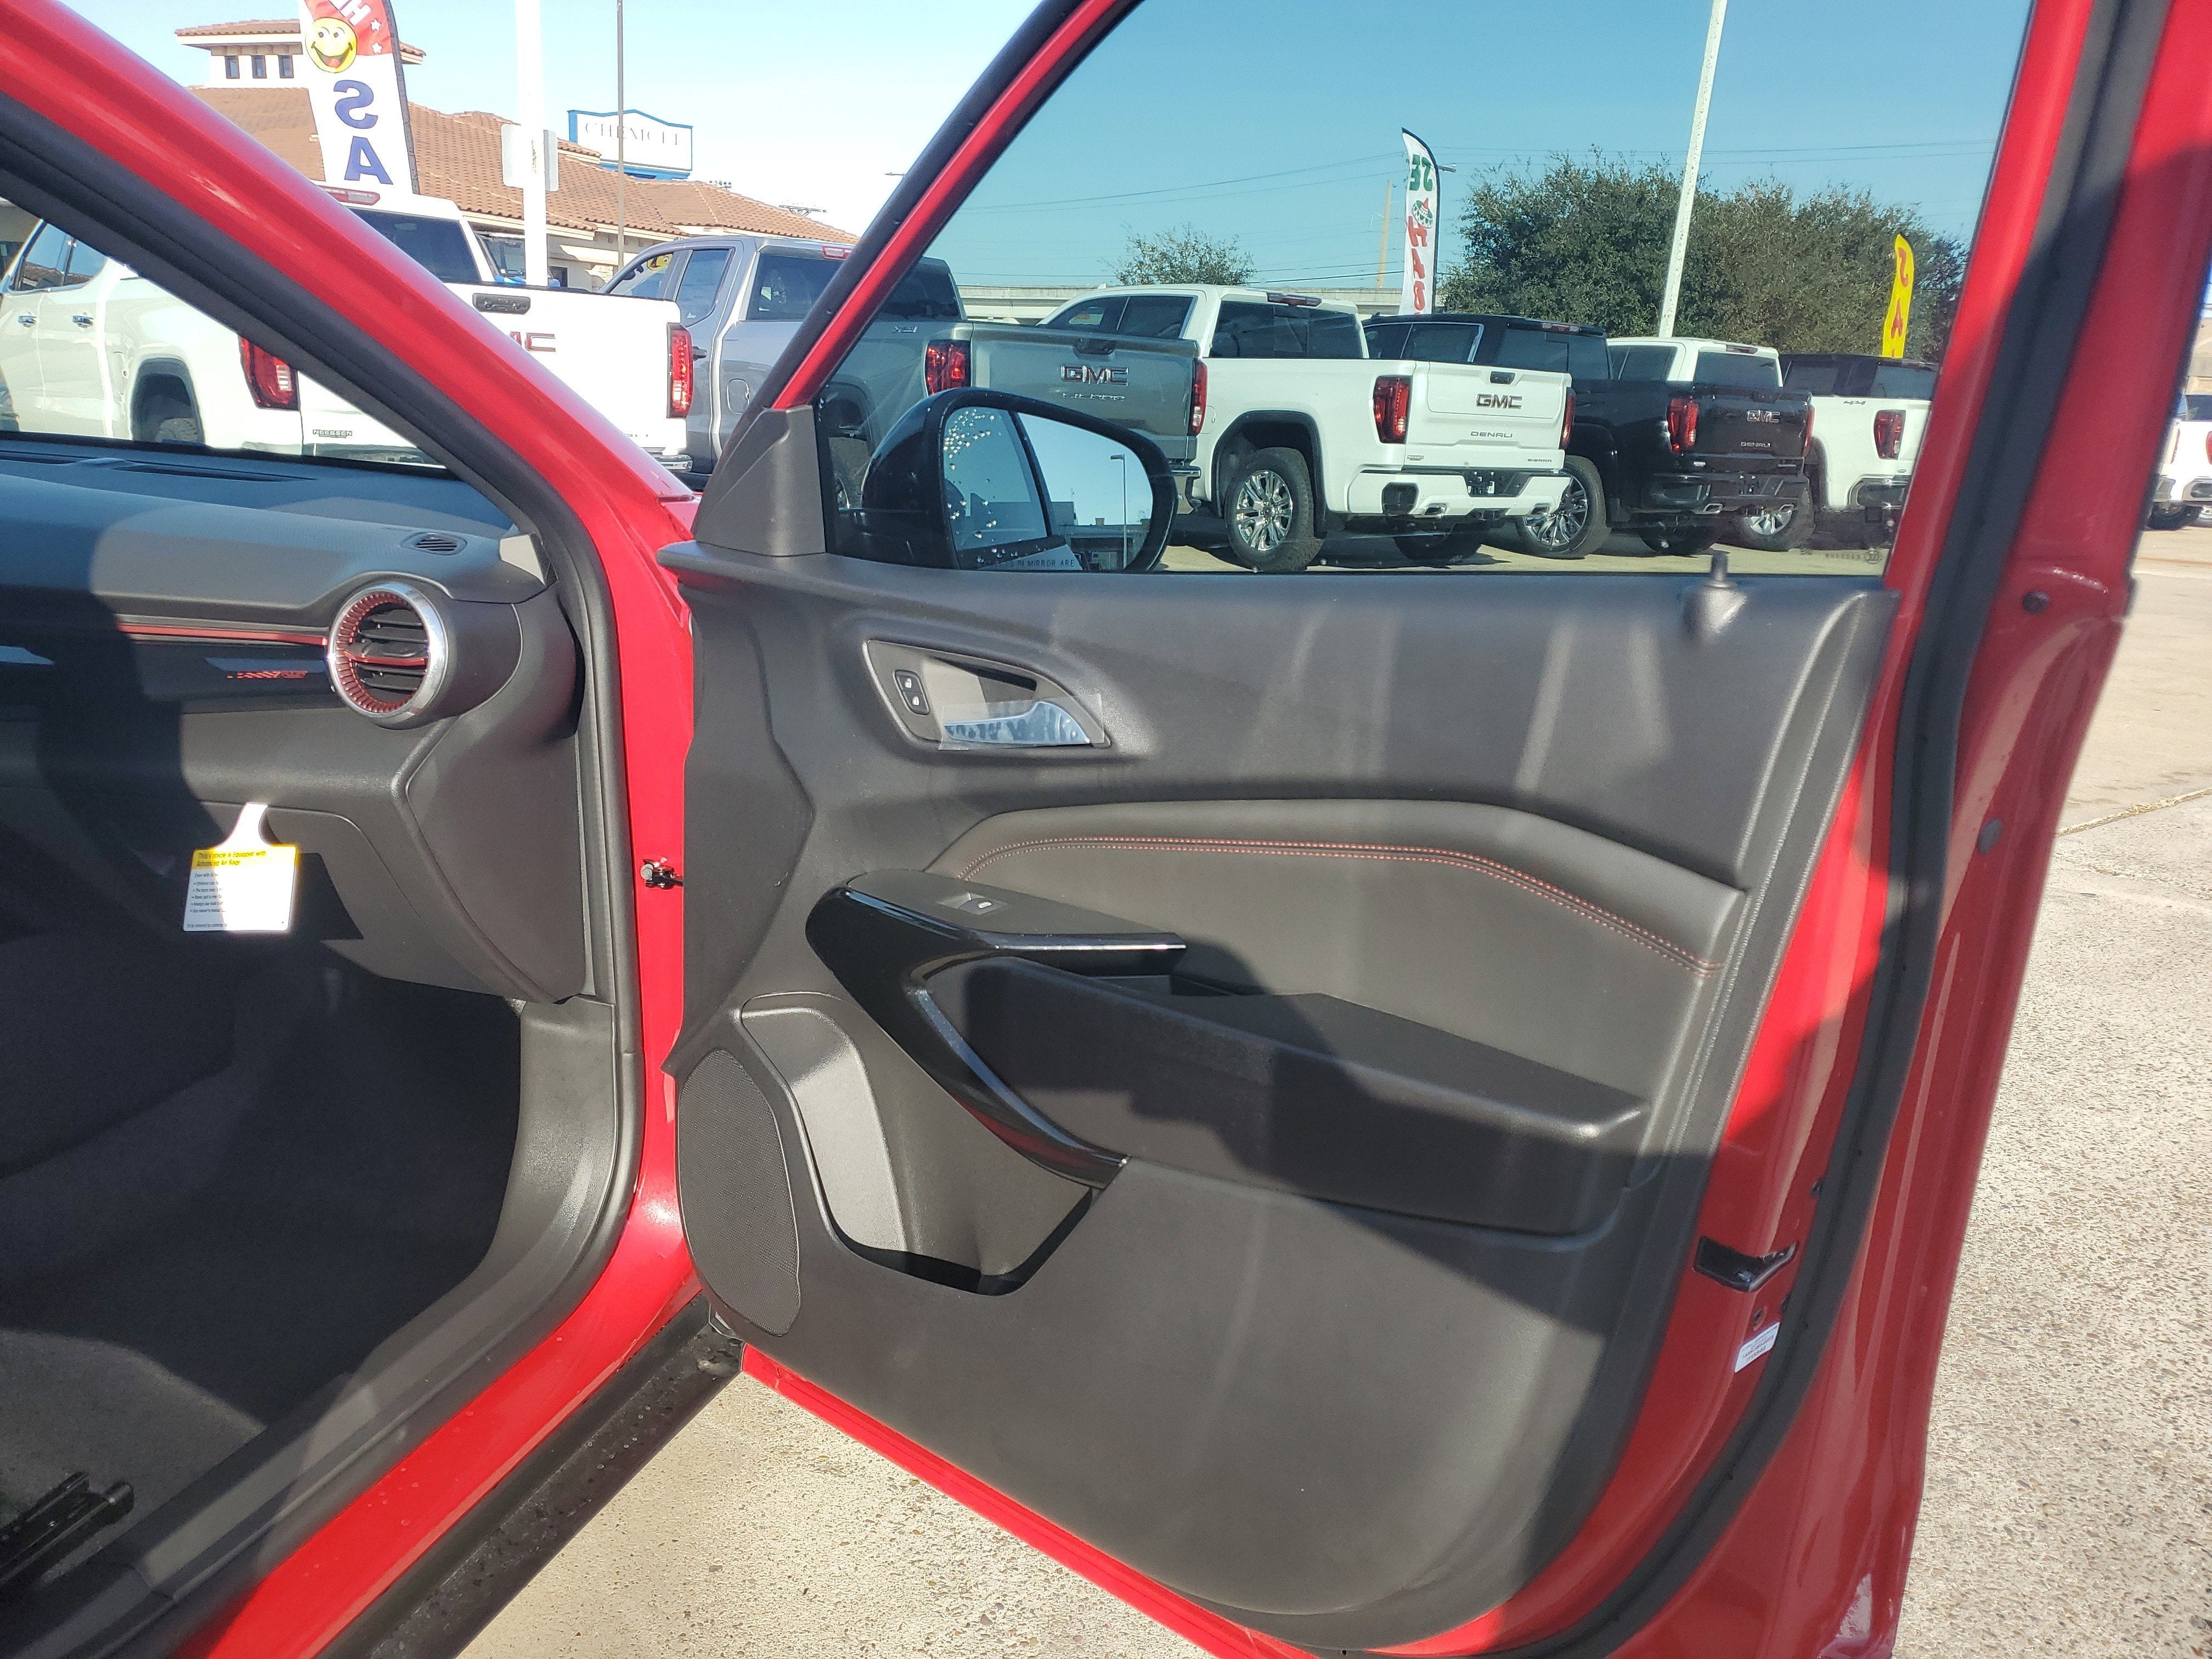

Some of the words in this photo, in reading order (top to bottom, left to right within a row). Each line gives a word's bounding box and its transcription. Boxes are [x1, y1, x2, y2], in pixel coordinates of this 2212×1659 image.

[1060, 364, 1129, 387] GMC
[1476, 393, 1522, 409] GMC
[1746, 409, 1780, 424] GMC
[1028, 559, 1056, 567] MIRROR
